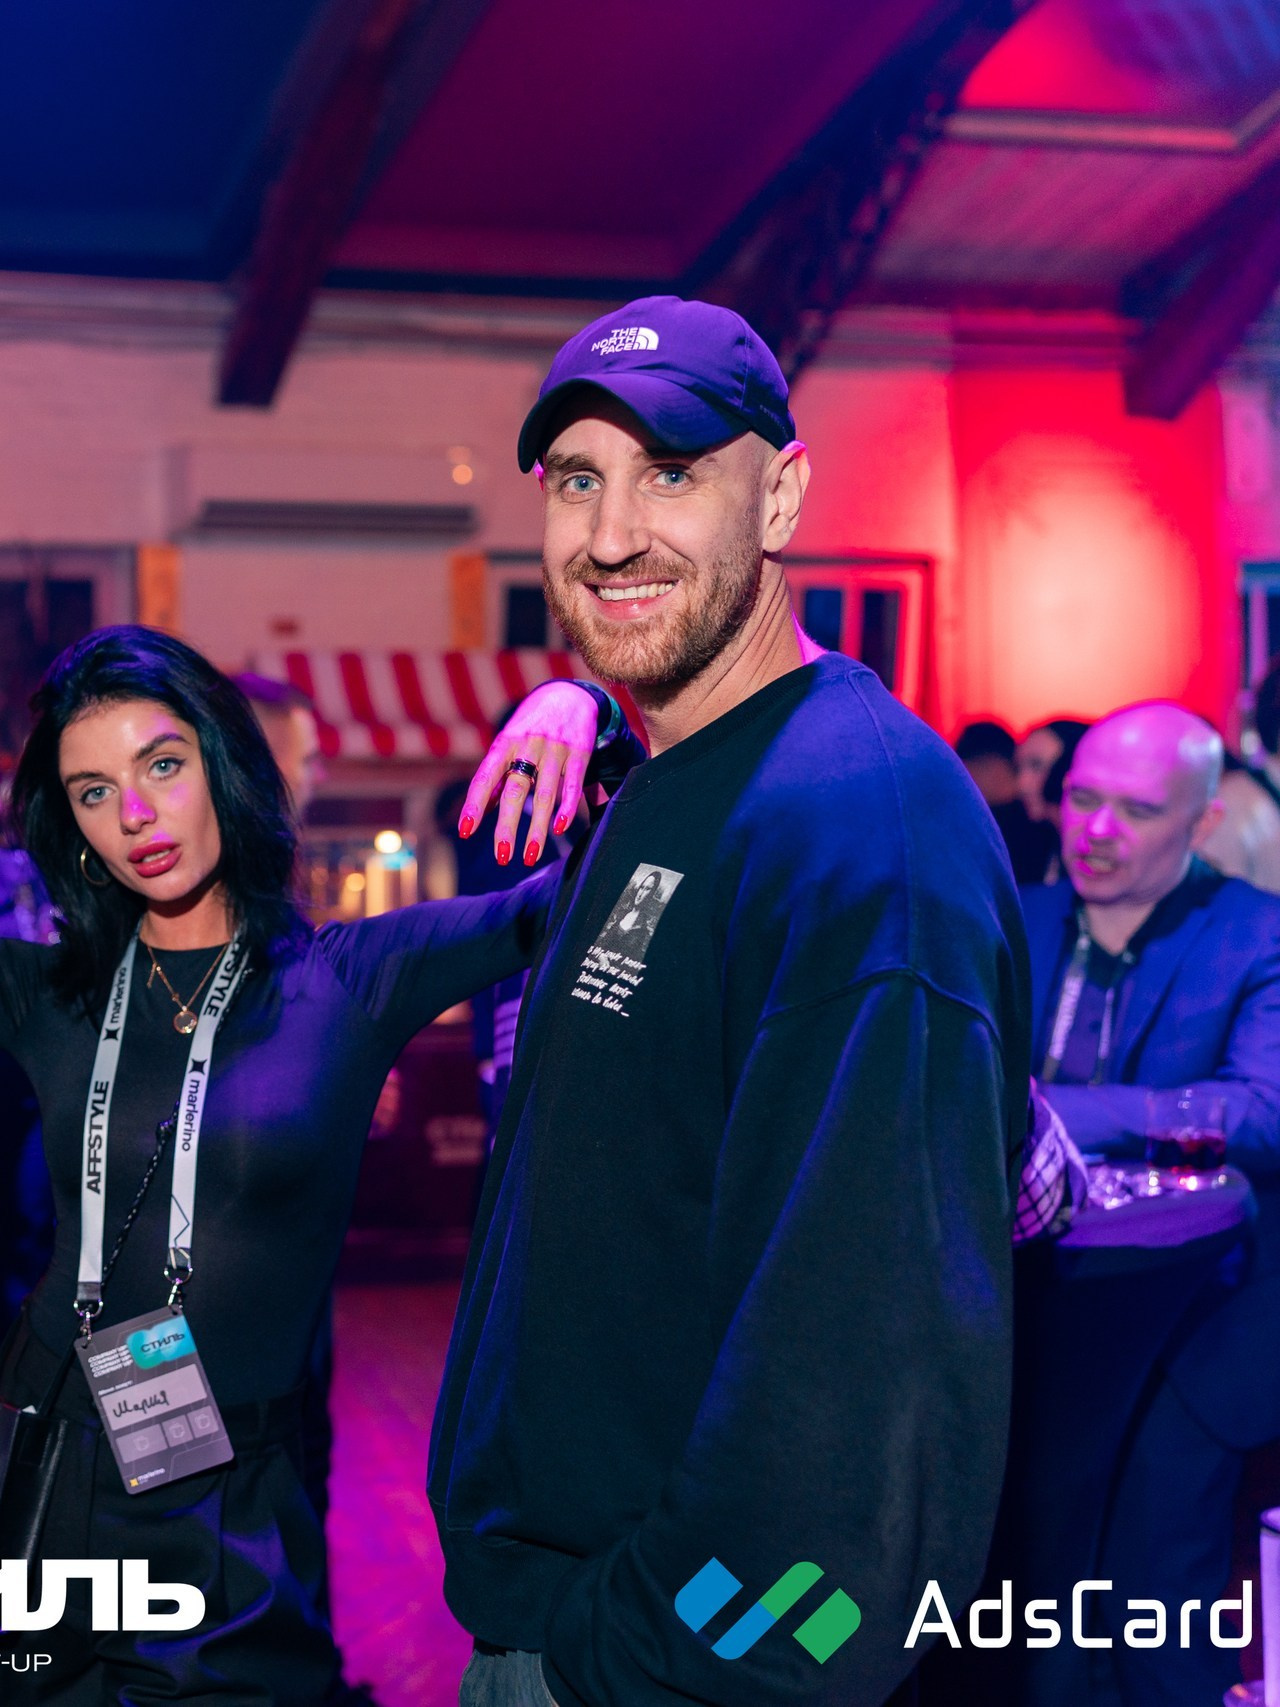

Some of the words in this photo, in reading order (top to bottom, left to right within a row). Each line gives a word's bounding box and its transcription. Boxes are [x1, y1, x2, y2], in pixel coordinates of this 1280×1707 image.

[611, 327, 639, 338] THE
[591, 335, 636, 352] NORTH
[600, 343, 634, 356] FACE
[181, 1078, 200, 1152] marlerino
[86, 1080, 110, 1195] AFFSTYLE
[141, 1333, 186, 1353] СТИЛЬ
